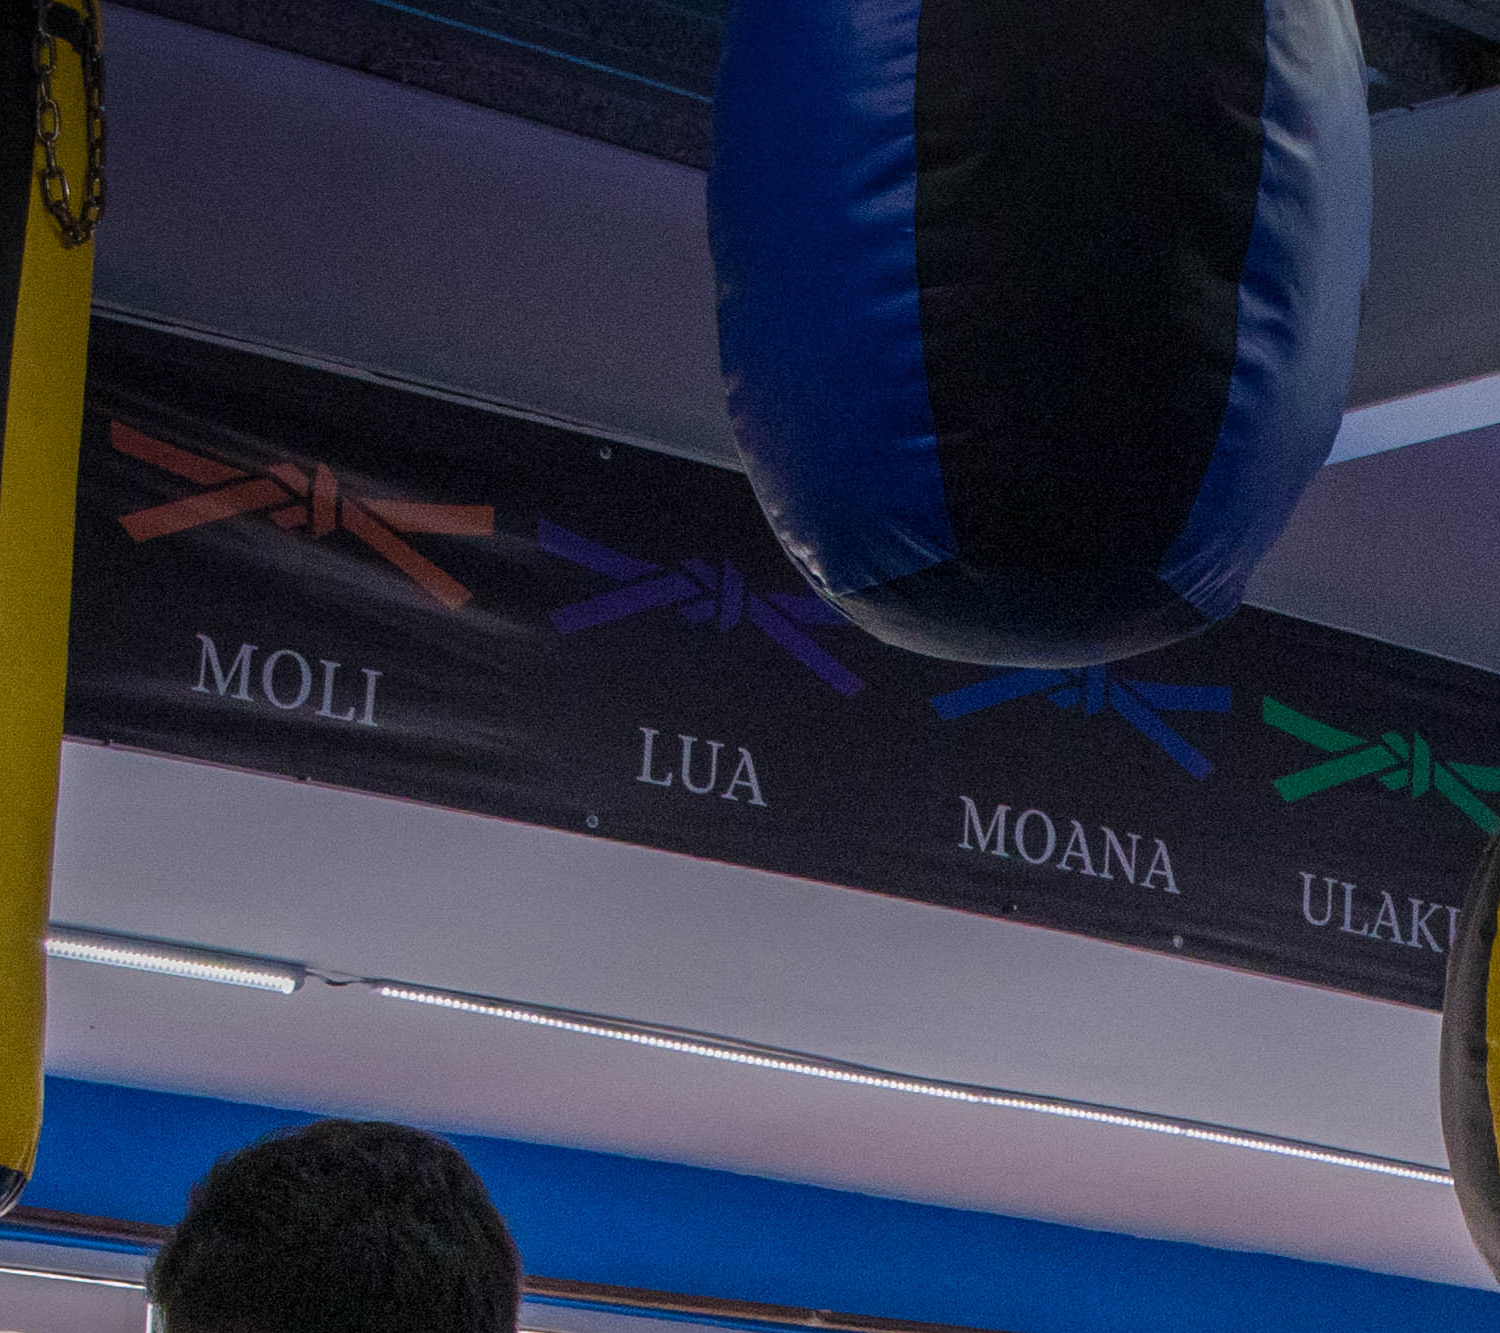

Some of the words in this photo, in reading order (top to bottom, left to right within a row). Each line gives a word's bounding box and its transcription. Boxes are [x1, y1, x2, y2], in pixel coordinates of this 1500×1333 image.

[192, 633, 384, 727] MOLI
[636, 727, 768, 807] LUA
[957, 795, 1181, 896] MOANA
